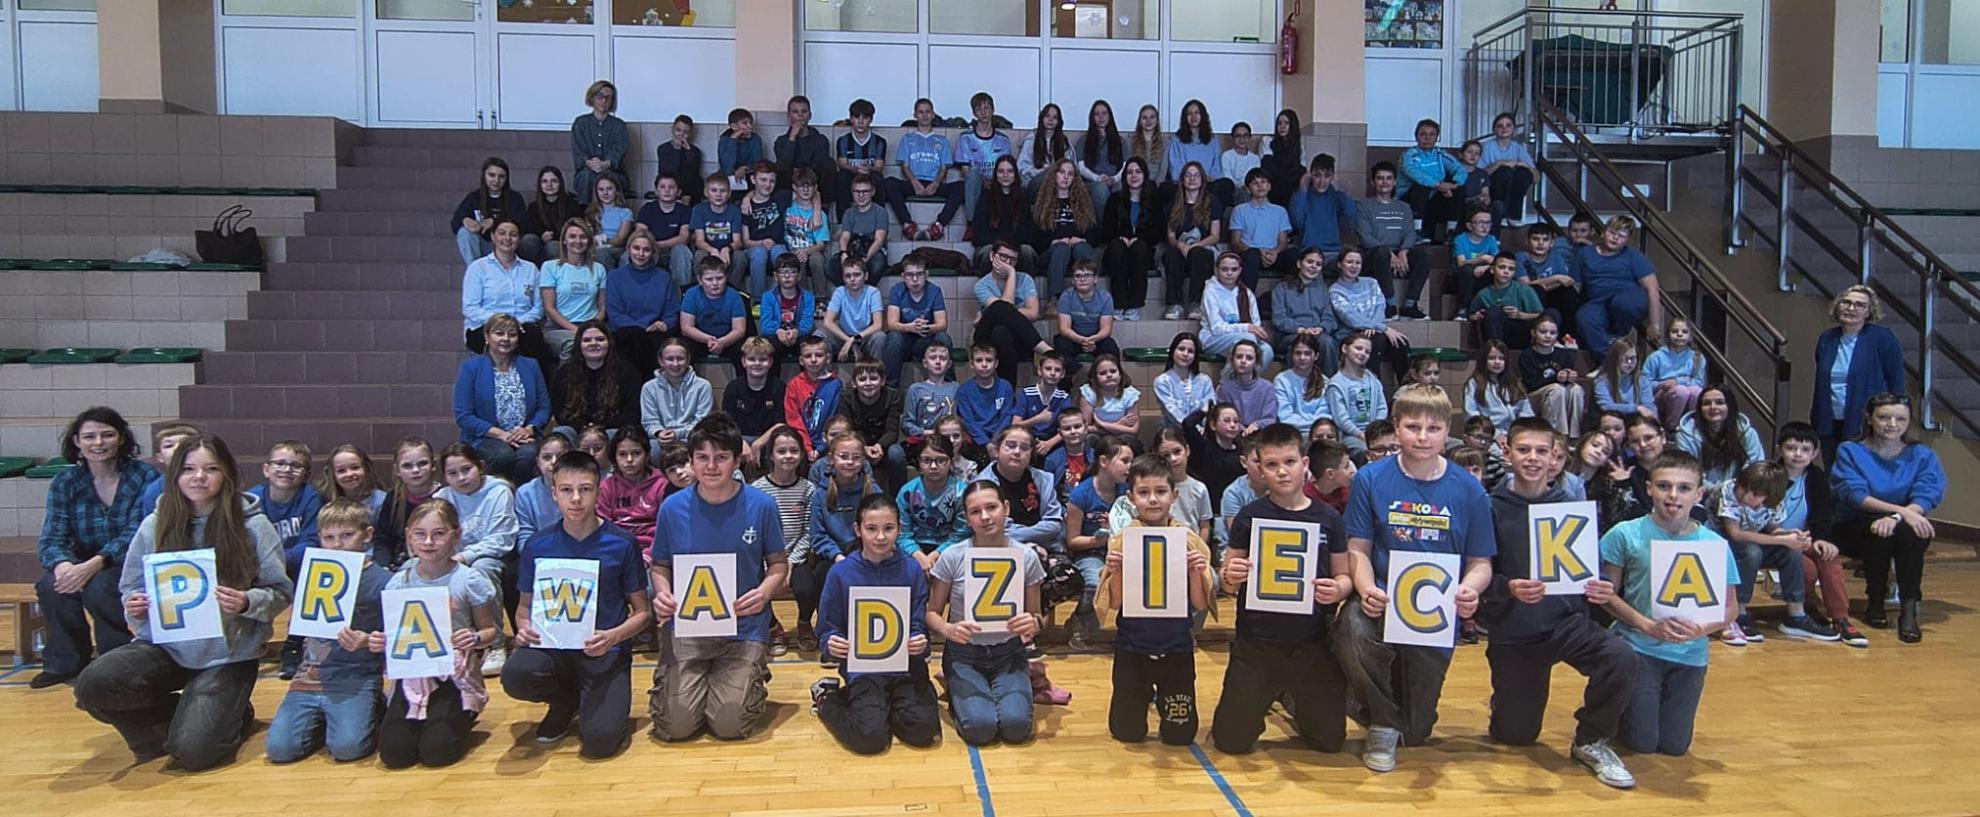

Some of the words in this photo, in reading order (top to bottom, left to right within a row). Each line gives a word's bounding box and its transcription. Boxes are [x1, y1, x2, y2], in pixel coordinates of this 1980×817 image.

[1143, 535, 1168, 609] I
[1256, 526, 1308, 602] E
[1533, 514, 1594, 582] K
[1655, 553, 1719, 607] A
[152, 560, 209, 630] P
[301, 558, 349, 623] R
[538, 577, 594, 622] W
[678, 566, 731, 621] A
[971, 558, 1017, 622] Z
[1393, 562, 1453, 634] C
[391, 600, 449, 660] A
[854, 598, 904, 660] D
[1170, 703, 1188, 717] 26
